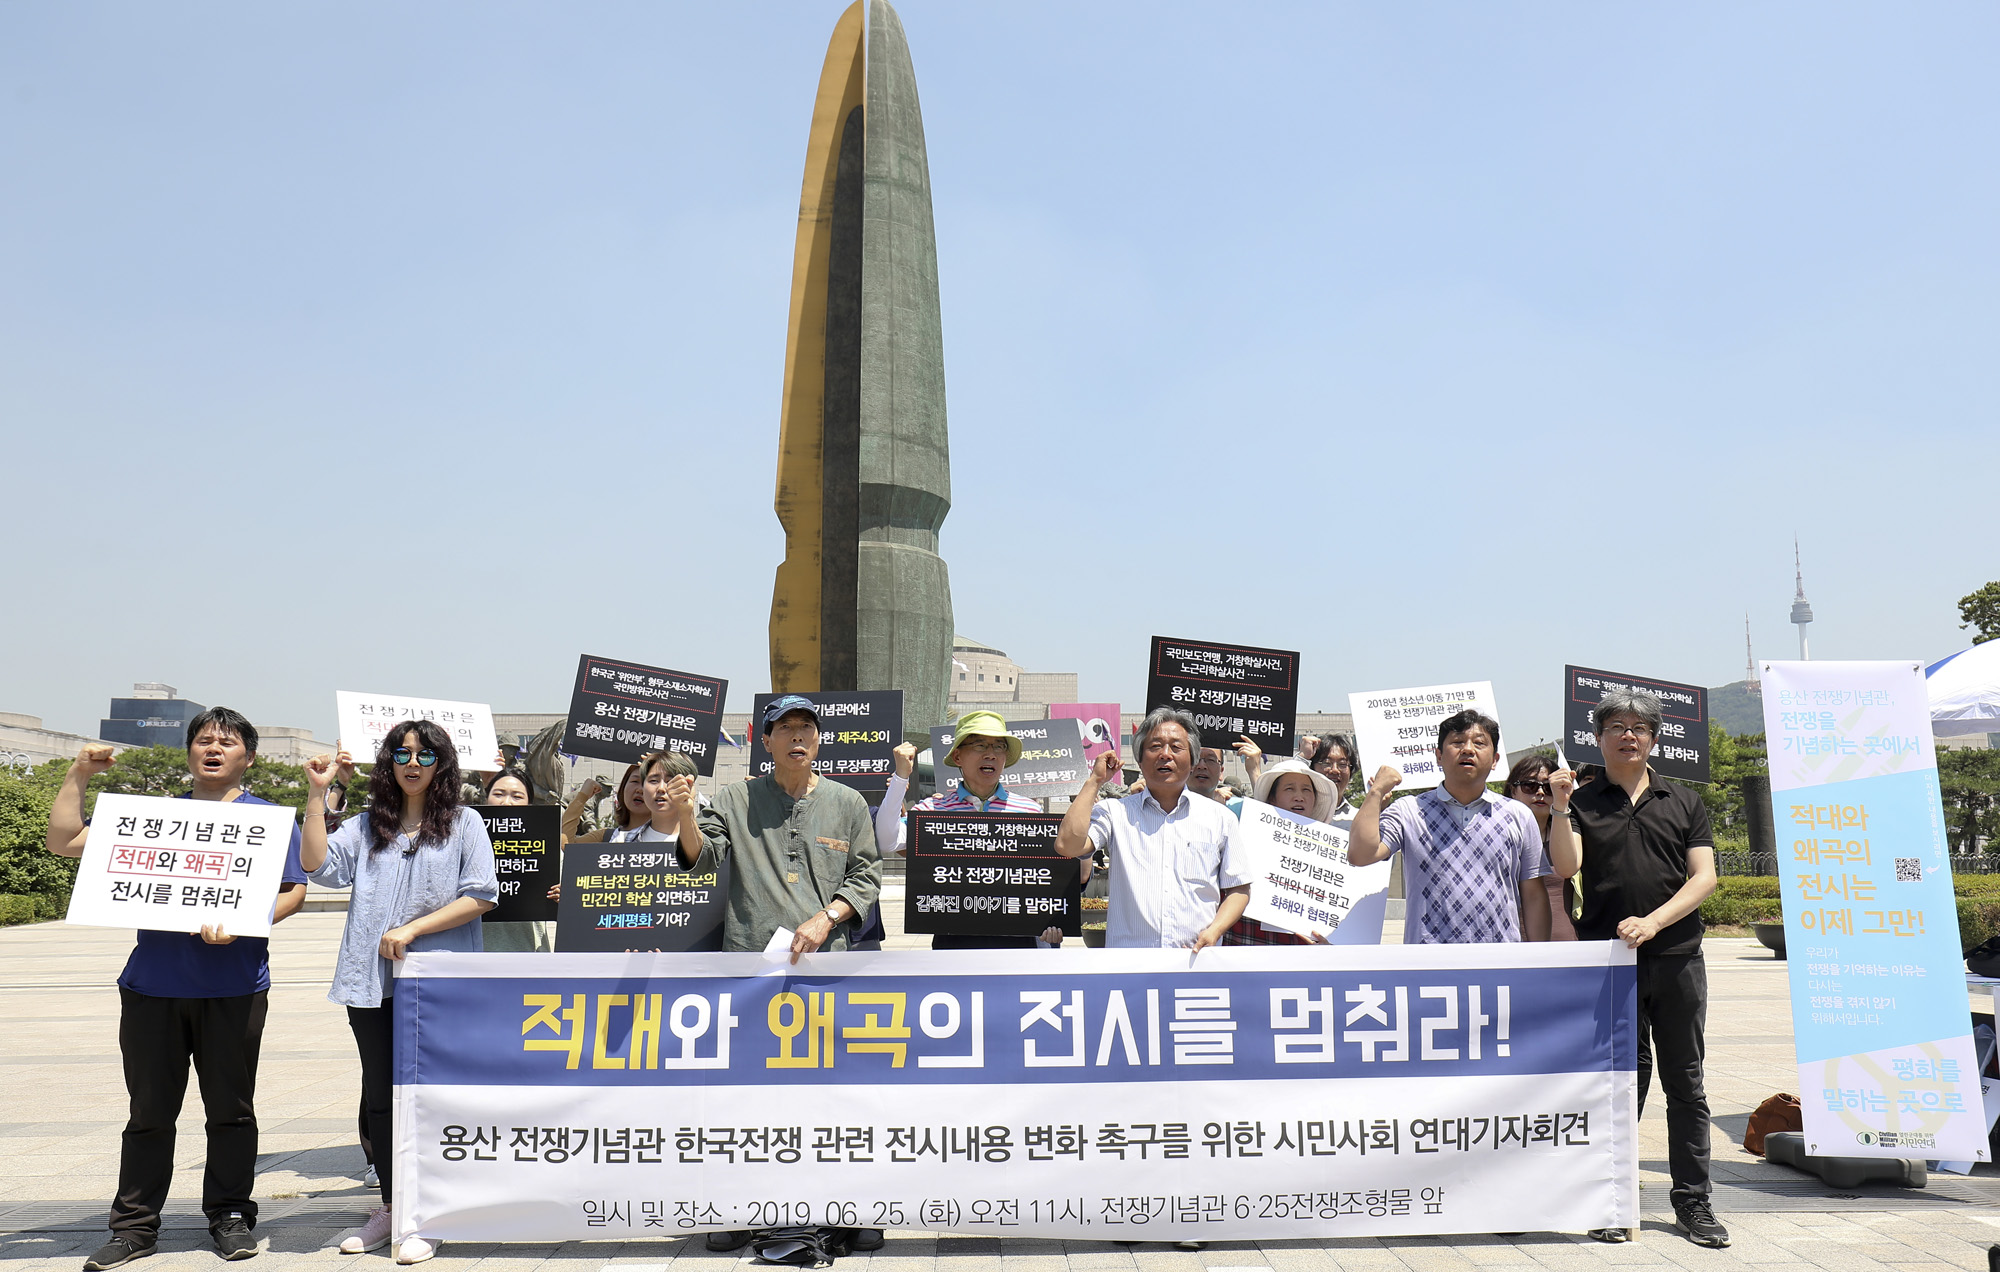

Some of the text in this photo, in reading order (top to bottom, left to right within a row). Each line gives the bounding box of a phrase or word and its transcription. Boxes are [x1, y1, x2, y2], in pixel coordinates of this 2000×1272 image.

[1165, 647, 1283, 672] 국민보도연맹, 거창학살사건,
[591, 666, 616, 680] 한국군
[1180, 662, 1245, 680] 노근리학살사건
[613, 682, 669, 700] 국민방위군사건
[1577, 676, 1600, 689] 한국군
[1170, 686, 1272, 711] 용산 전쟁기념관은
[1367, 697, 1398, 708] 2018년
[1445, 692, 1466, 702] 71만
[1466, 690, 1476, 700] 명
[1778, 690, 1895, 707] 용산 전쟁기념관,
[594, 701, 697, 732] 용산 전쟁기념관은
[1384, 709, 1401, 720] 용산
[1402, 705, 1445, 718] 전쟁기념관
[1780, 711, 1837, 730] 전쟁을
[1196, 713, 1244, 733] 이야기를
[1247, 719, 1285, 738] 말하라
[1398, 724, 1440, 739] 전쟁기념
[616, 730, 666, 750] 이야기를
[669, 738, 707, 757] 말하라
[836, 730, 890, 744] 제주4.3이
[1783, 736, 1920, 756] 기념하는 곳에서
[1392, 744, 1424, 758] 적대와
[1663, 745, 1700, 764] 말하라
[836, 759, 890, 772] 무장투쟁?
[1402, 761, 1434, 774] 화해와
[1024, 770, 1077, 782] 무장투쟁?
[1260, 812, 1292, 832] 2018년
[1790, 804, 1870, 831] 적대와
[924, 822, 992, 836] 국민보도연맹,
[493, 840, 546, 855] 한국군의
[942, 838, 1018, 852] 노근리학살사건
[1272, 830, 1292, 846] 용산
[1293, 836, 1338, 861] 전쟁기념관
[1793, 838, 1872, 866] 왜곡의
[115, 848, 178, 872] 적대와
[598, 854, 626, 868] 용산
[932, 866, 1052, 885] 용산 전쟁기념관은
[1280, 855, 1345, 888] 전쟁기념관은
[498, 881, 520, 896] 여?
[576, 874, 630, 890] 베트남전
[633, 874, 660, 889] 당시
[1268, 872, 1350, 910] 적대와 대결 말고
[1796, 873, 1877, 901] 전시는
[110, 881, 243, 909] 전시를 멈춰라
[581, 890, 710, 908] 민간인 학살 외면하고
[964, 895, 1022, 914] 이야기를
[1025, 898, 1068, 915] 말하라
[1270, 894, 1340, 929] 화해와 협력을
[597, 912, 691, 928] 세계평화 기여?
[1800, 908, 1926, 937] 이제 그만!
[1805, 946, 1839, 959] 우리가
[1806, 964, 1927, 977] 전쟁을 기억하는 이유는
[1808, 980, 1842, 992] 다시는
[1810, 996, 1896, 1010] 전쟁을 겪지 않기
[521, 983, 1512, 1071] 적대와 왜곡의 전시를 멈춰라!
[1811, 1012, 1884, 1026] 위해서입니다.
[1892, 1058, 1962, 1082] 평화를
[1822, 1088, 1967, 1114] 말하는 곳으로
[439, 1111, 1592, 1164] 용산 전쟁기념관 한국전쟁 관련 전시내용 변화 촉구를 위한 시민사회 연대기자회견
[1900, 1138, 1936, 1148] 시민연대
[582, 1200, 634, 1228] 일시
[642, 1200, 664, 1227] 및
[672, 1200, 724, 1228] 장소
[747, 1201, 816, 1227] 2019.
[825, 1201, 863, 1227] 06.
[872, 1201, 910, 1226] 25.
[919, 1198, 961, 1228] (화)
[967, 1196, 1020, 1226] 오전
[1028, 1196, 1092, 1227] 11시,
[1100, 1194, 1228, 1226] 전쟁기념관
[1420, 1187, 1444, 1218] 앞
